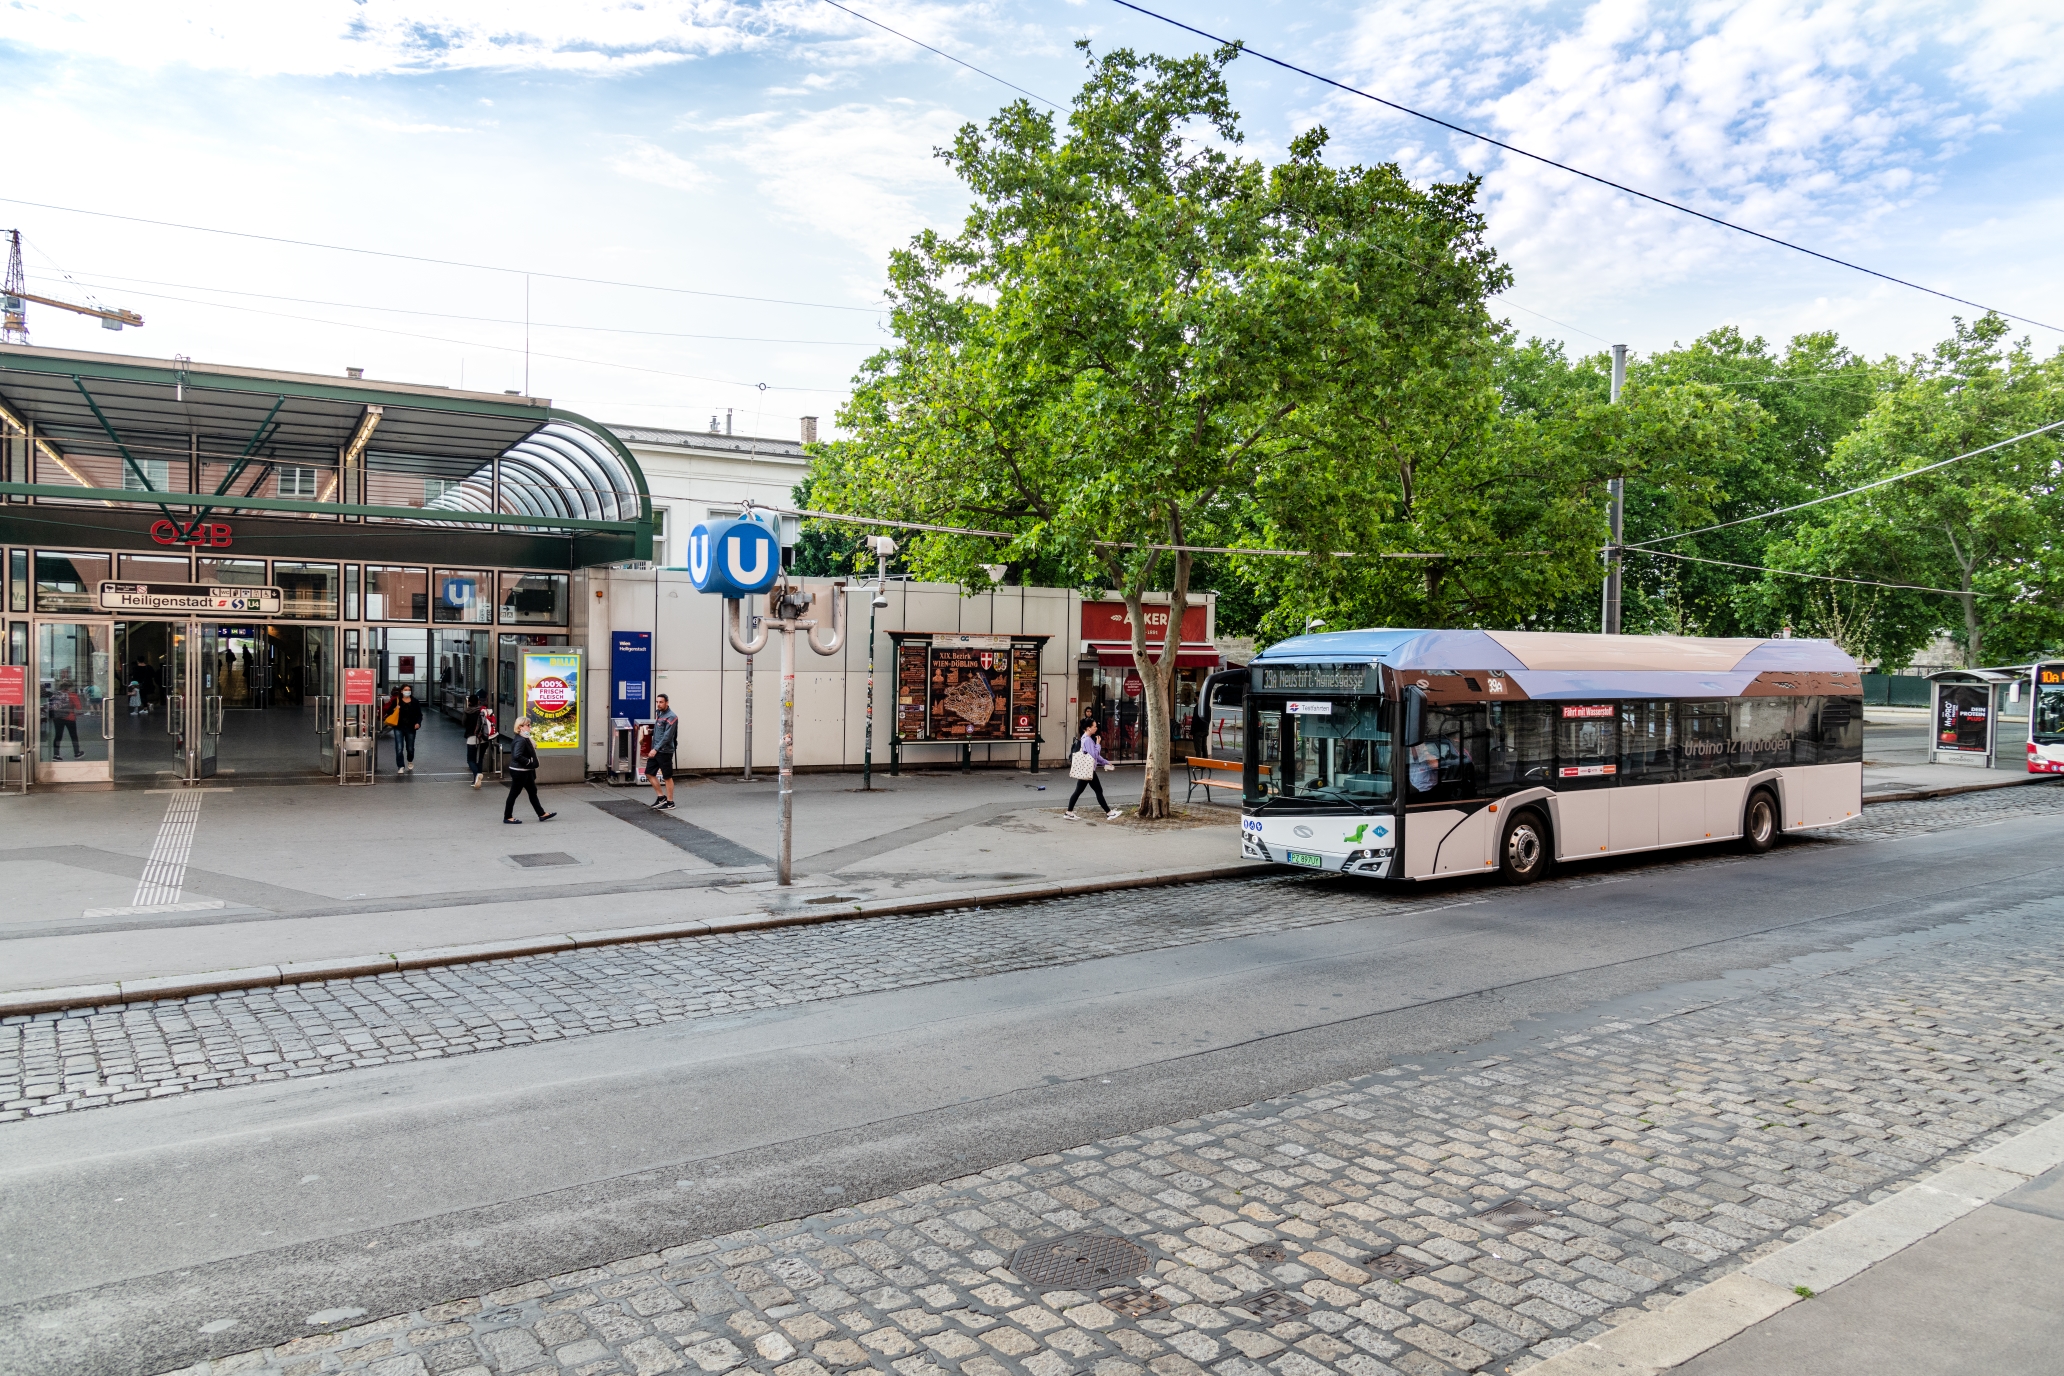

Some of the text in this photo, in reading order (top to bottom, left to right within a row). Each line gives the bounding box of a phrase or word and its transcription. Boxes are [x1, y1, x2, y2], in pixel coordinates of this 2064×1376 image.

[691, 534, 708, 583] U
[727, 537, 769, 585] U
[121, 594, 213, 608] Heiligenstadt
[449, 584, 470, 605] U
[247, 600, 260, 608] U4
[1123, 612, 1168, 626] AKER
[932, 660, 978, 668] WIEN-DÖBLING
[1264, 669, 1277, 688] 39A
[1316, 671, 1363, 688] Agnesgasse
[2041, 671, 2059, 683] 10A
[1487, 678, 1503, 693] 39A
[1301, 704, 1330, 712] Testfahrten
[1564, 706, 1613, 717] Fährt mit Wasserstoff
[1684, 738, 1790, 756] Urbino 12 hydrogen
